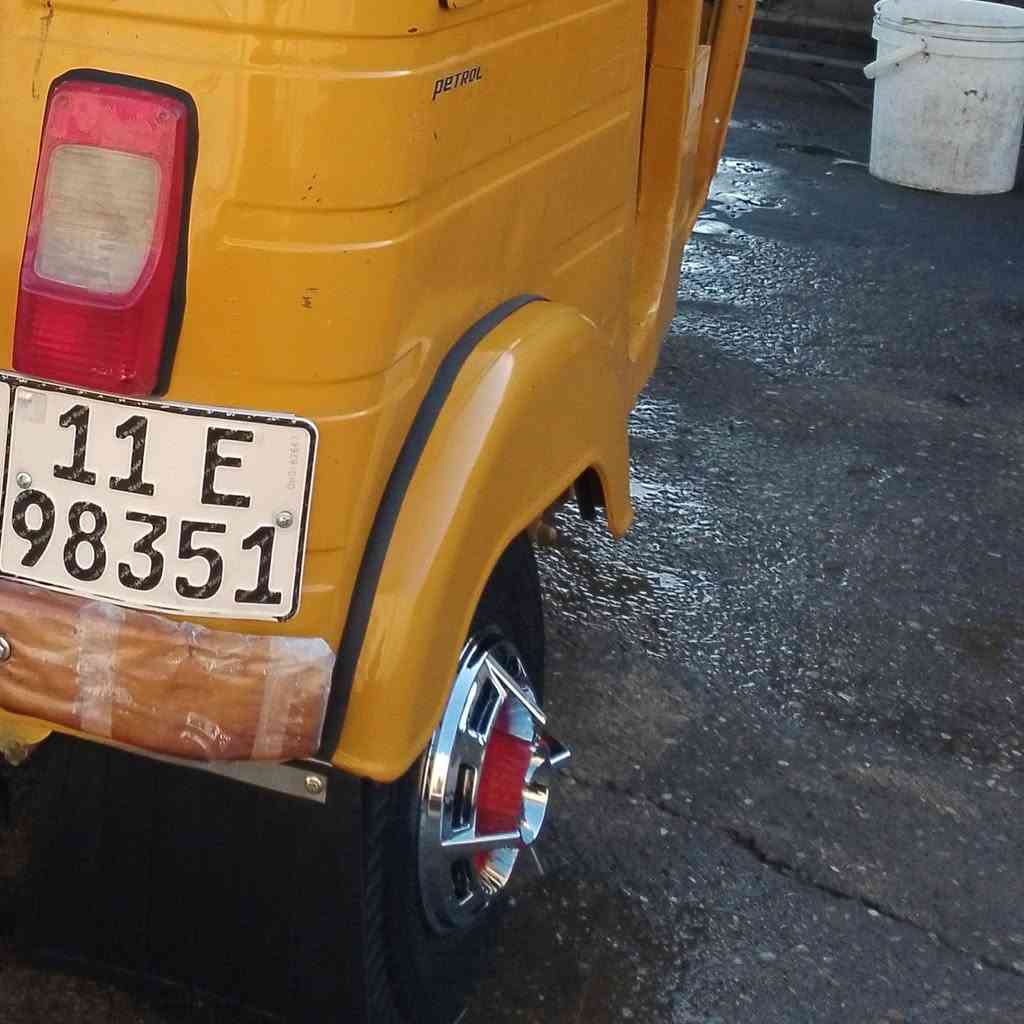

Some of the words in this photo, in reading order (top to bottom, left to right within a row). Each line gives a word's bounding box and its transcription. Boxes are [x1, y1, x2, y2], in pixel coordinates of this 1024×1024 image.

[53, 404, 155, 496] 11
[201, 426, 254, 508] E
[12, 489, 282, 605] 98351
